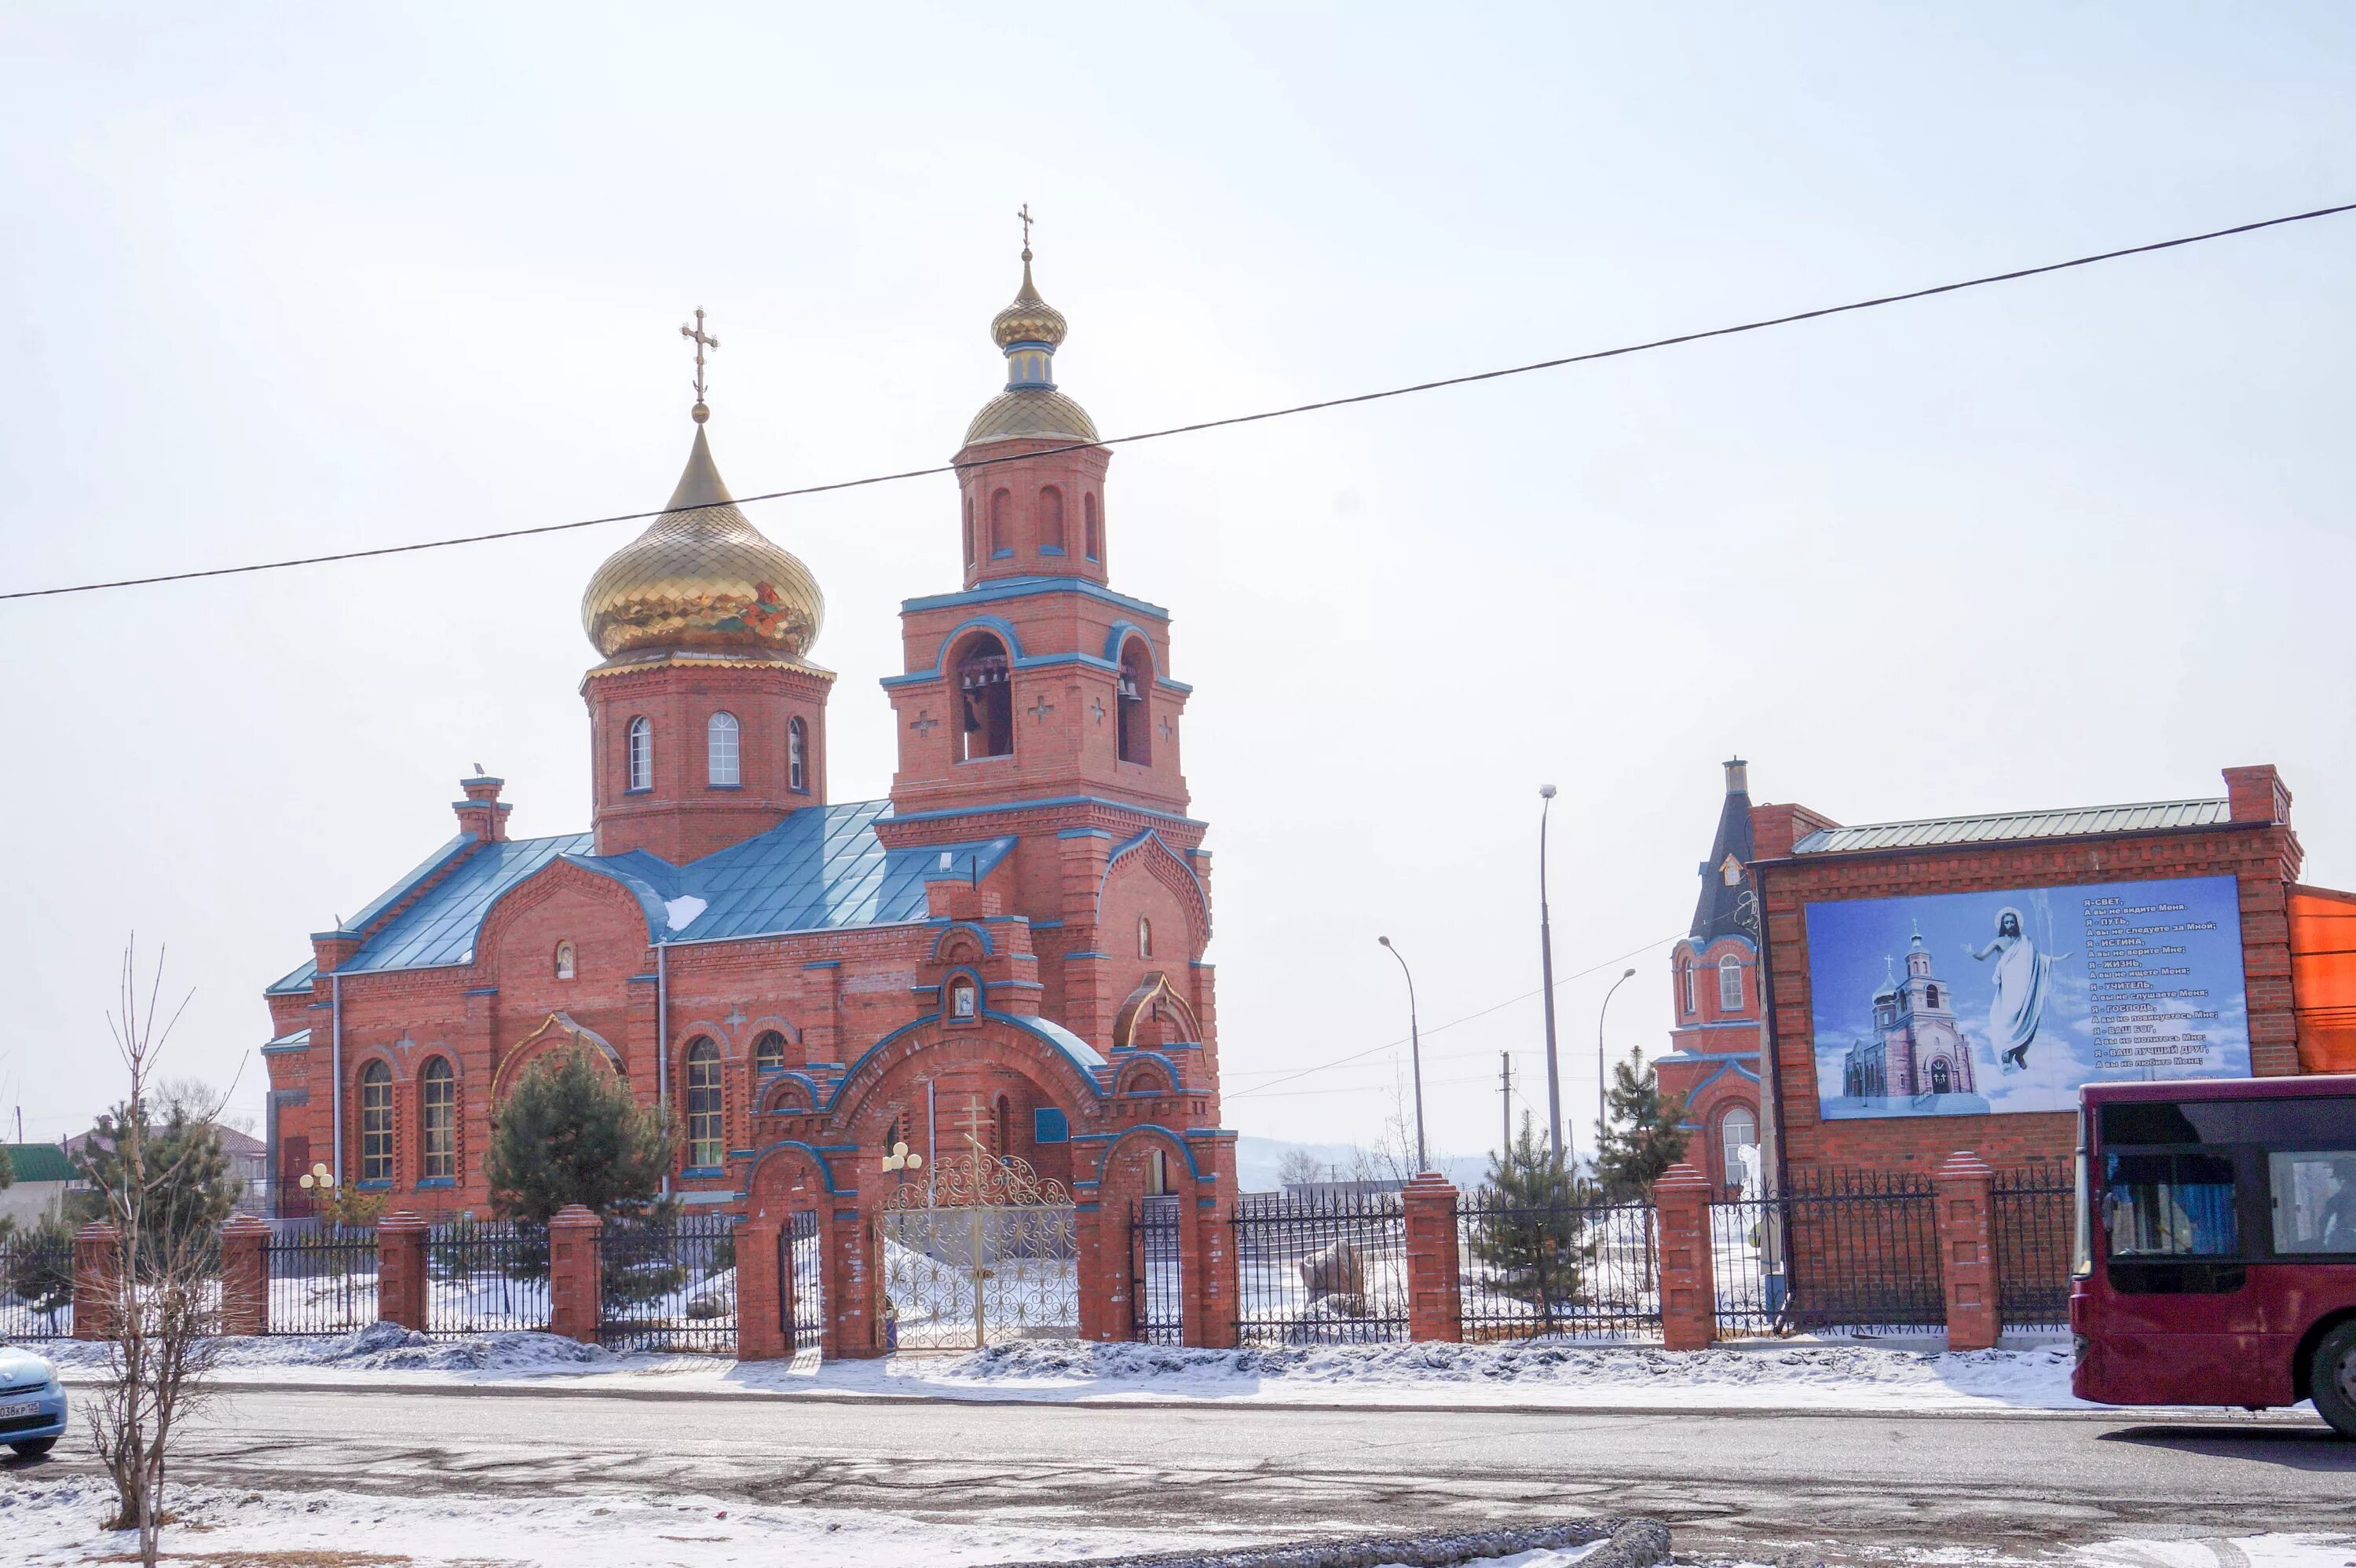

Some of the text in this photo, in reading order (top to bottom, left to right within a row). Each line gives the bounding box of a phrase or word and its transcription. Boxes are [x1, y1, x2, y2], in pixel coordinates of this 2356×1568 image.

[2124, 905, 2156, 914] видите
[2126, 926, 2169, 934] следуете
[2186, 921, 2216, 930] Мной;
[2102, 938, 2145, 947] ИСТИНА,
[2103, 959, 2142, 968] ЖИЗНЬ,
[2105, 981, 2153, 990] УЧИТЕЛЬ,
[2131, 991, 2177, 1000] слушаете
[2107, 1003, 2157, 1012] ГОСПОДЬ,
[2131, 1012, 2192, 1021] повинуетесь
[2134, 1025, 2157, 1033] БОГ,
[2134, 1035, 2180, 1044] молитесь
[2135, 1045, 2178, 1055] ЛУЧШИЙ
[2181, 1045, 2209, 1054] ДРУГ,
[2174, 1057, 2203, 1066] Меня;
